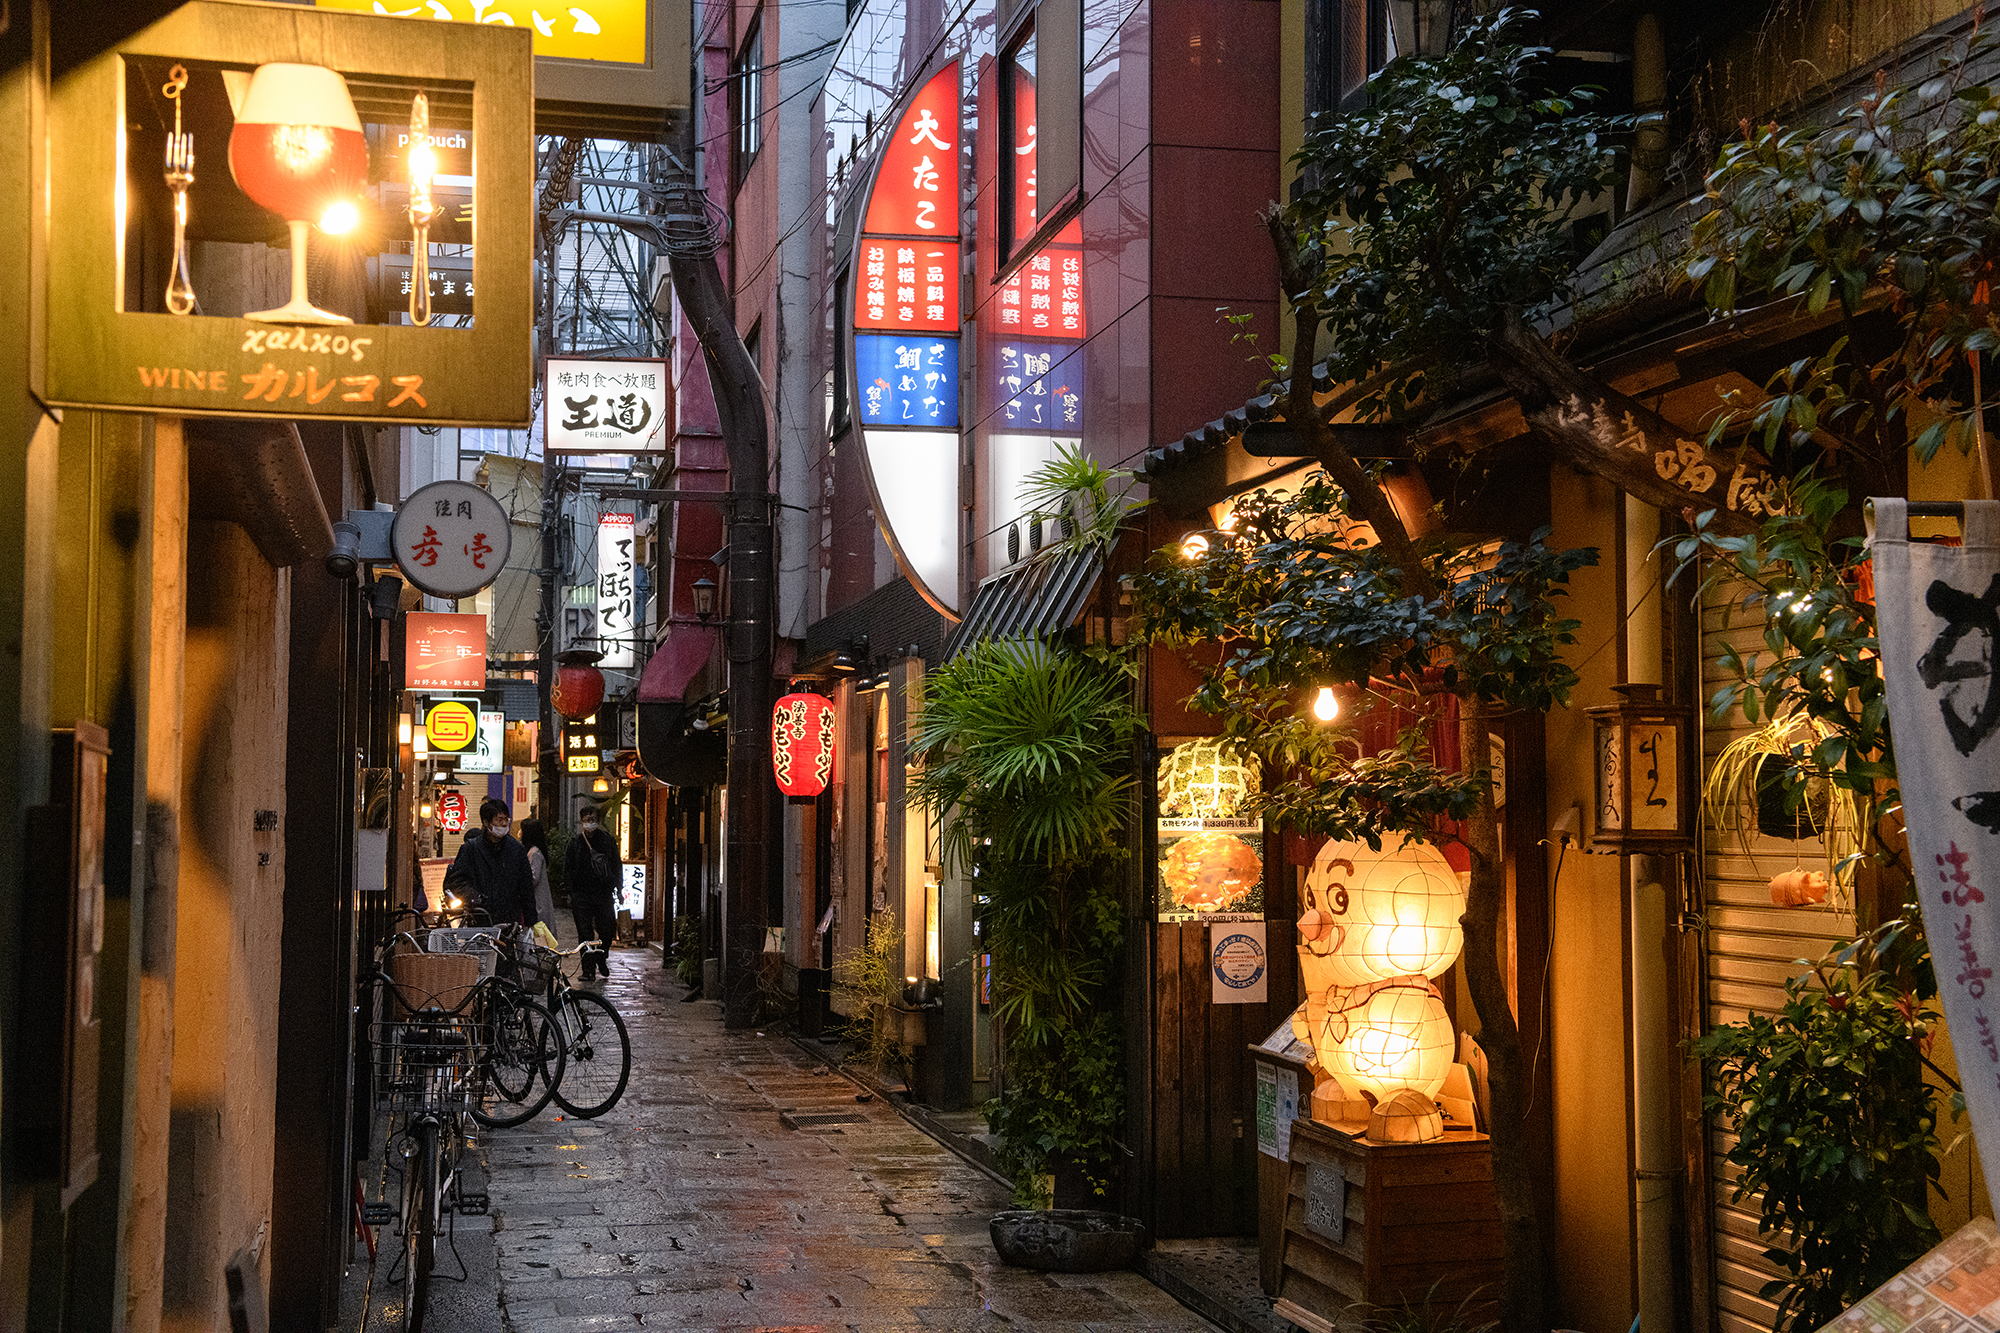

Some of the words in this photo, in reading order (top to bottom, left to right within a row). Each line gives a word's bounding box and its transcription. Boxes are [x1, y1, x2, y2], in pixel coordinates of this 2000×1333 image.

[910, 109, 951, 230] 大たこ
[867, 246, 886, 321] お好み焼き
[897, 247, 916, 322] 鉄板焼き
[926, 251, 945, 321] 一品料理
[137, 366, 228, 392] WINE
[240, 361, 428, 408] カルコス
[557, 371, 657, 391] 焼肉食べ放題
[561, 392, 652, 435] 王道
[894, 345, 922, 420] 鯛めし
[922, 342, 947, 418] さかな
[584, 430, 622, 439] PREMIUM
[791, 701, 808, 740] 法善寺
